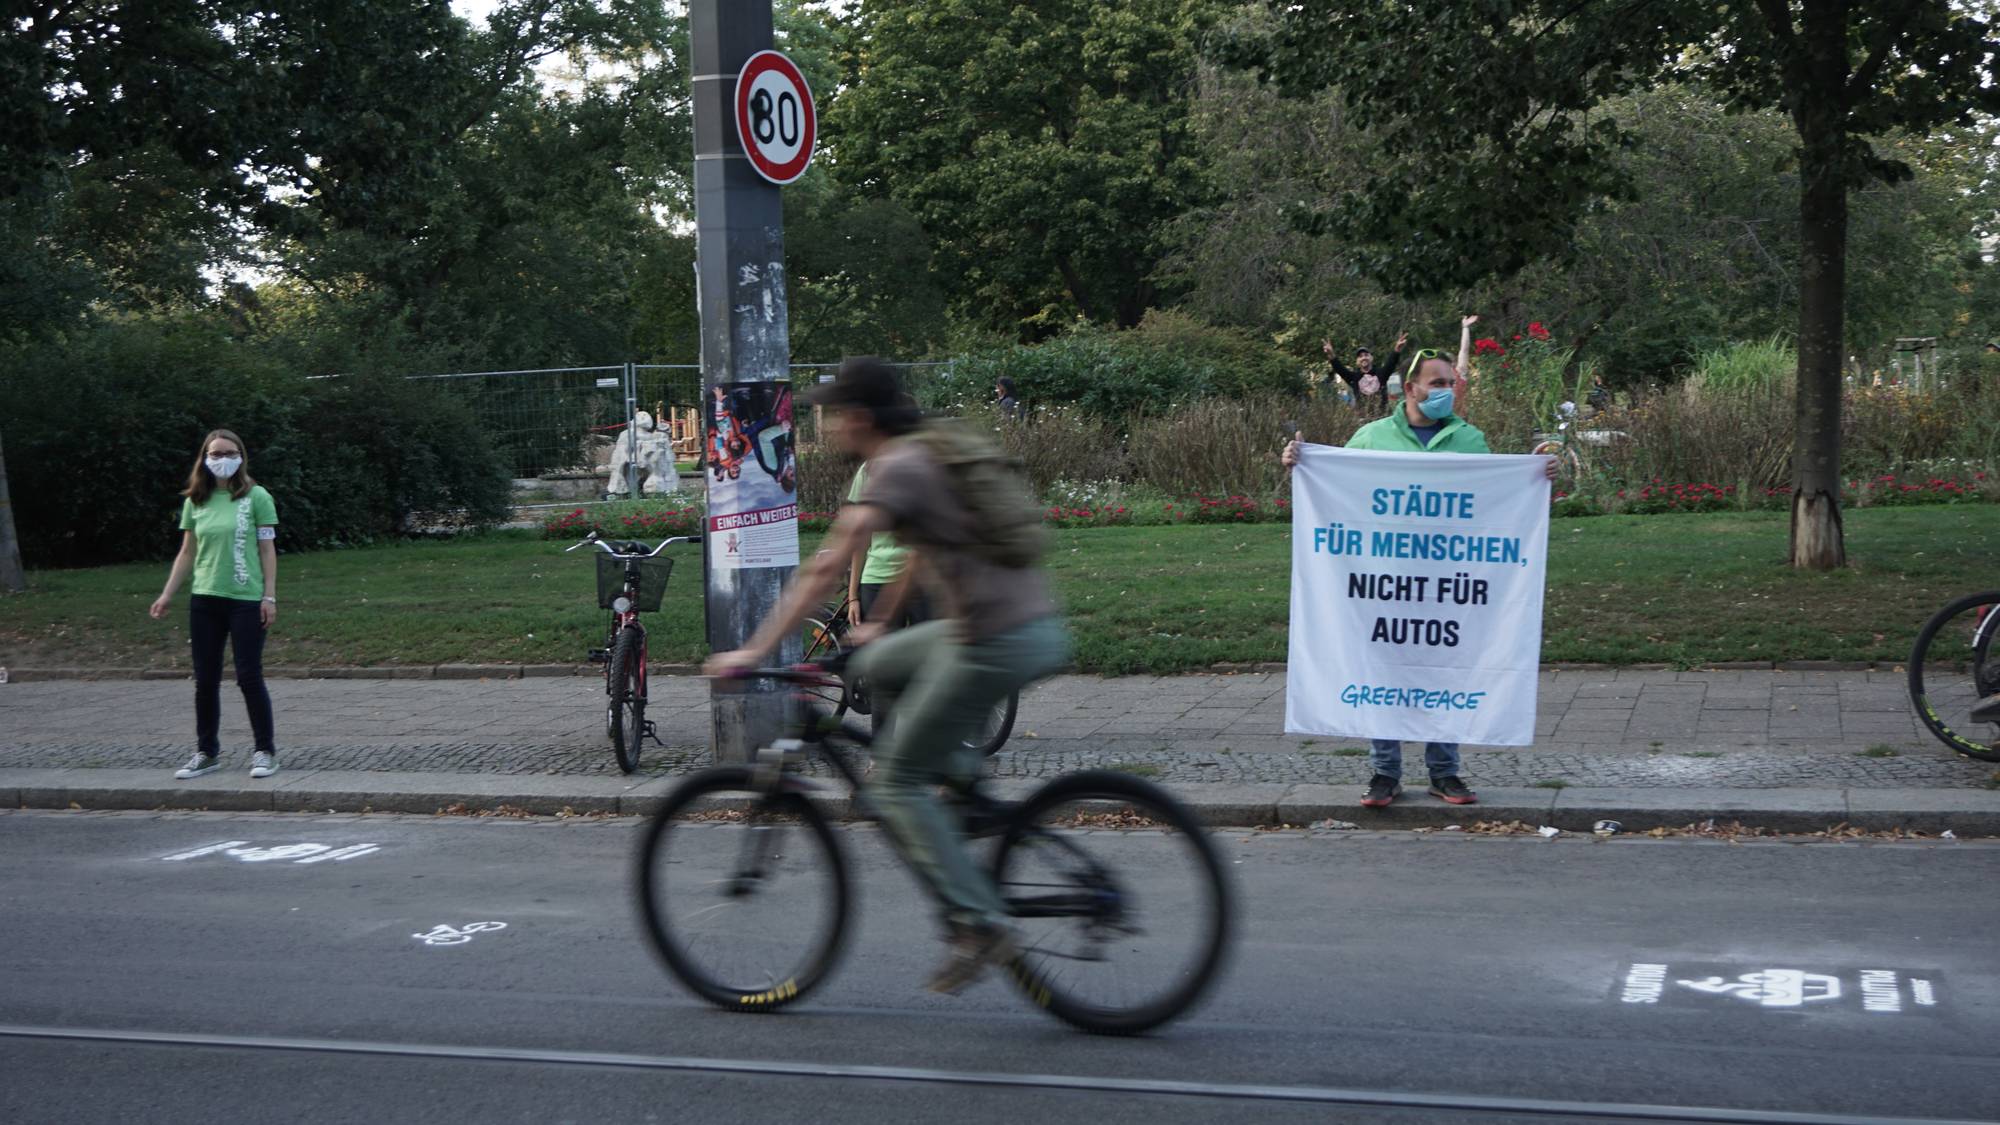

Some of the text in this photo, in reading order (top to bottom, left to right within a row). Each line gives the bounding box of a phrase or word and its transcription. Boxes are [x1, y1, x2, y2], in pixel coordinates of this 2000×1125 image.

[751, 88, 798, 147] 80
[717, 513, 758, 530] EINFACH
[760, 507, 790, 522] WEITER
[1372, 485, 1474, 519] STÄDTE
[1314, 522, 1527, 567] FÜR MENSCHEN,
[1348, 572, 1489, 606] NICHT FÜR
[1371, 616, 1460, 648] AUTOS
[1341, 684, 1486, 711] GREENPEACE
[1621, 963, 1668, 1003] SOLUTION
[1859, 970, 1901, 1011] POLLUTION
